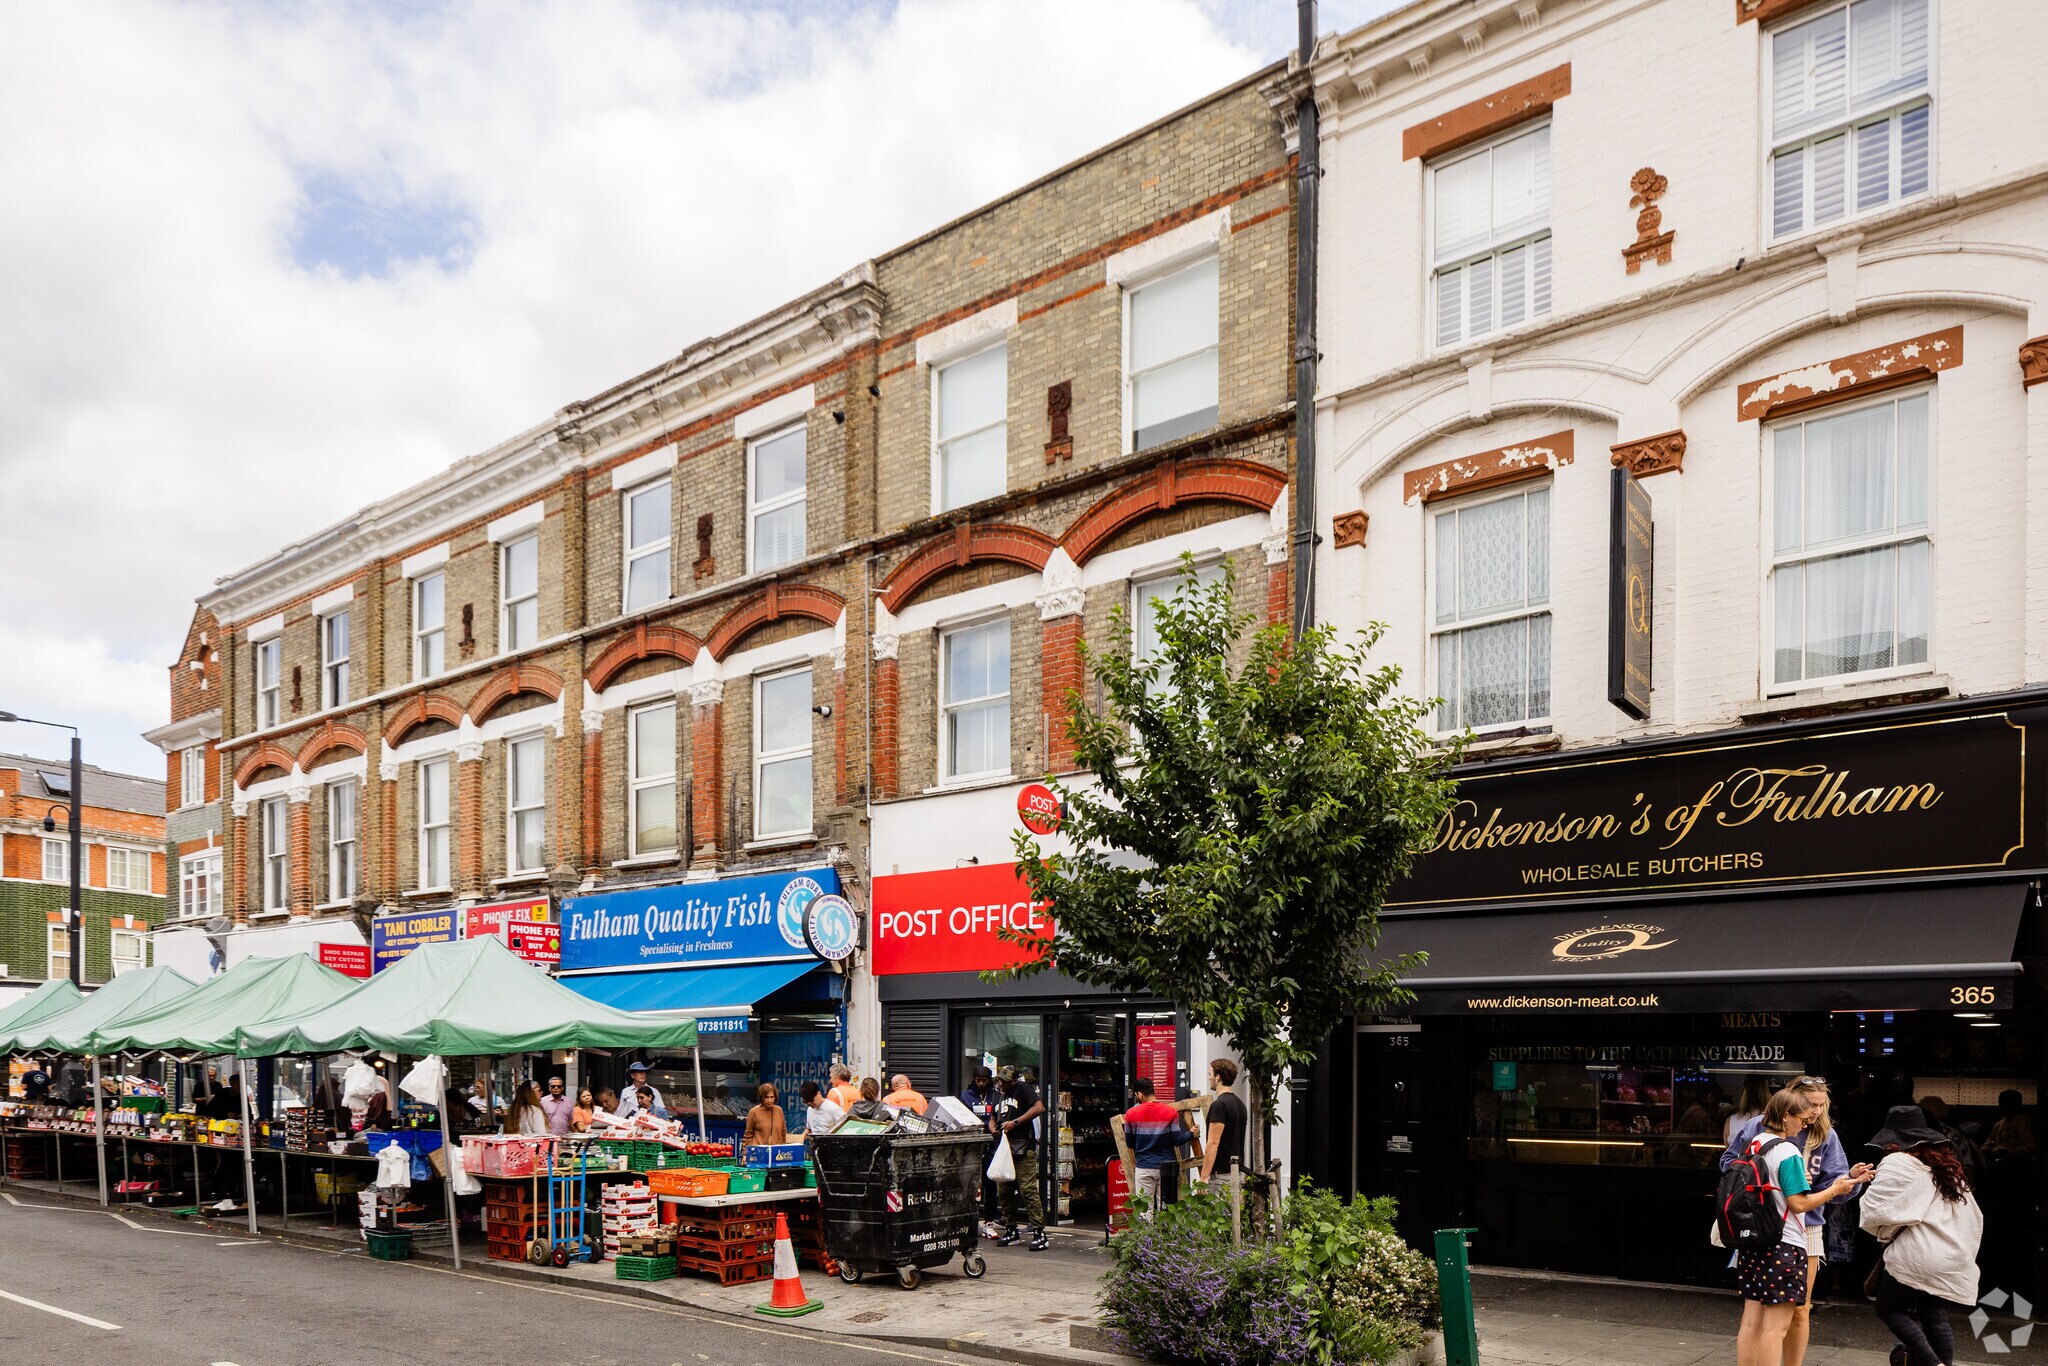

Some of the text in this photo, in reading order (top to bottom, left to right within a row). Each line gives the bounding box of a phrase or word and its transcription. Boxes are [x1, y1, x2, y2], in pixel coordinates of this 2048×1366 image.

[1030, 794, 1054, 811] POST
[1659, 781, 1724, 850] of
[1716, 764, 1944, 827] Fulham
[1522, 852, 1764, 884] WHOLESALE BUTCHERS
[779, 878, 822, 906] FULHAM QUAL
[482, 909, 513, 925] PHONE
[515, 908, 531, 920] FIX
[569, 891, 772, 941] Fulham Quality Fish
[879, 901, 1045, 939] POST OFFICE
[384, 921, 406, 936] TANI
[409, 916, 451, 934] COBBLER
[510, 924, 560, 936] PHONE FIX
[528, 942, 544, 950] BUY
[639, 940, 733, 957] Specialising in Freshness
[1467, 994, 1659, 1009] www.dickenson-meat.co.uk
[1950, 986, 1996, 1005] 365
[697, 1019, 744, 1032] 073811811
[1720, 1012, 1781, 1028] MEATS
[1390, 1036, 1409, 1046] 365
[1488, 1045, 1785, 1061] SUPPLIERS TO THE CATERING TRADE
[775, 1061, 829, 1076] FULHAM
[774, 1077, 830, 1094] QUATY
[788, 1095, 807, 1112] FIS
[909, 1232, 932, 1242] Market
[924, 1238, 960, 1252] 0208 753 1100
